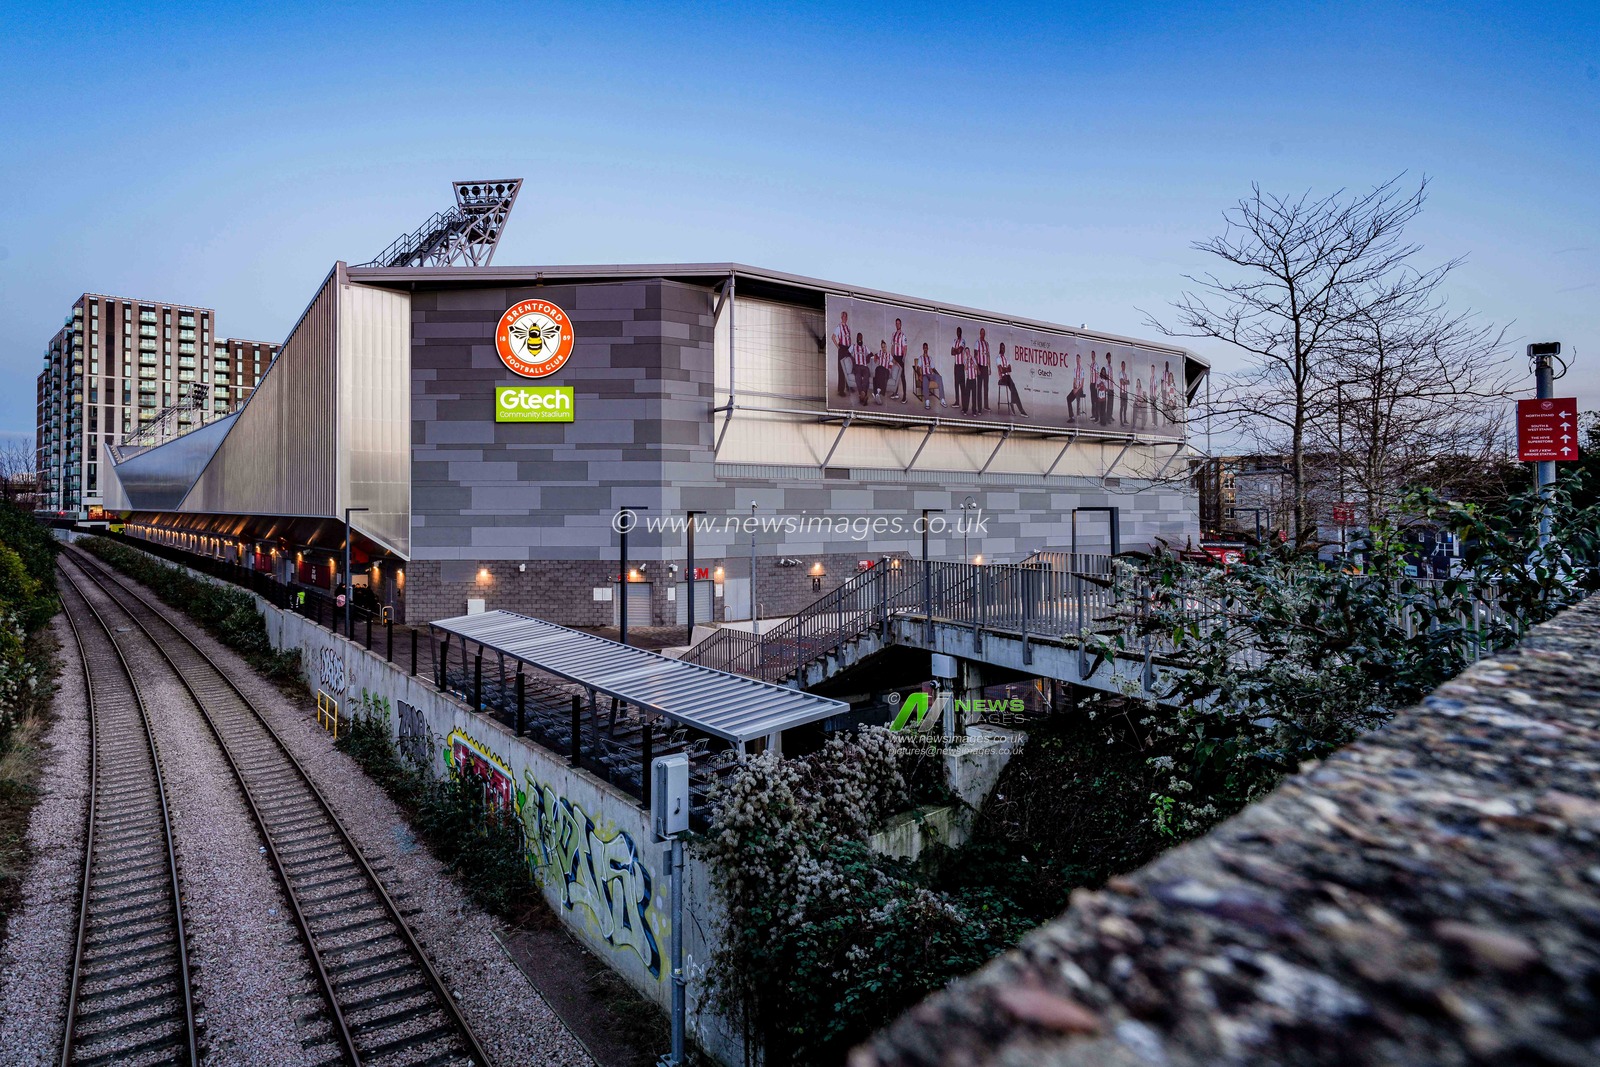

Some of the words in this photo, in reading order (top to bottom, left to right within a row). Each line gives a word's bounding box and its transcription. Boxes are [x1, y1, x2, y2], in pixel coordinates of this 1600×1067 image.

[506, 303, 562, 322] BRENTFORD
[506, 355, 544, 374] FOOTBALL
[545, 354, 564, 371] CLUB
[1014, 345, 1058, 366] BRENTFORD
[1059, 352, 1069, 368] FC
[1038, 368, 1052, 377] Gtech
[500, 389, 570, 410] Gtech
[500, 411, 540, 419] Community
